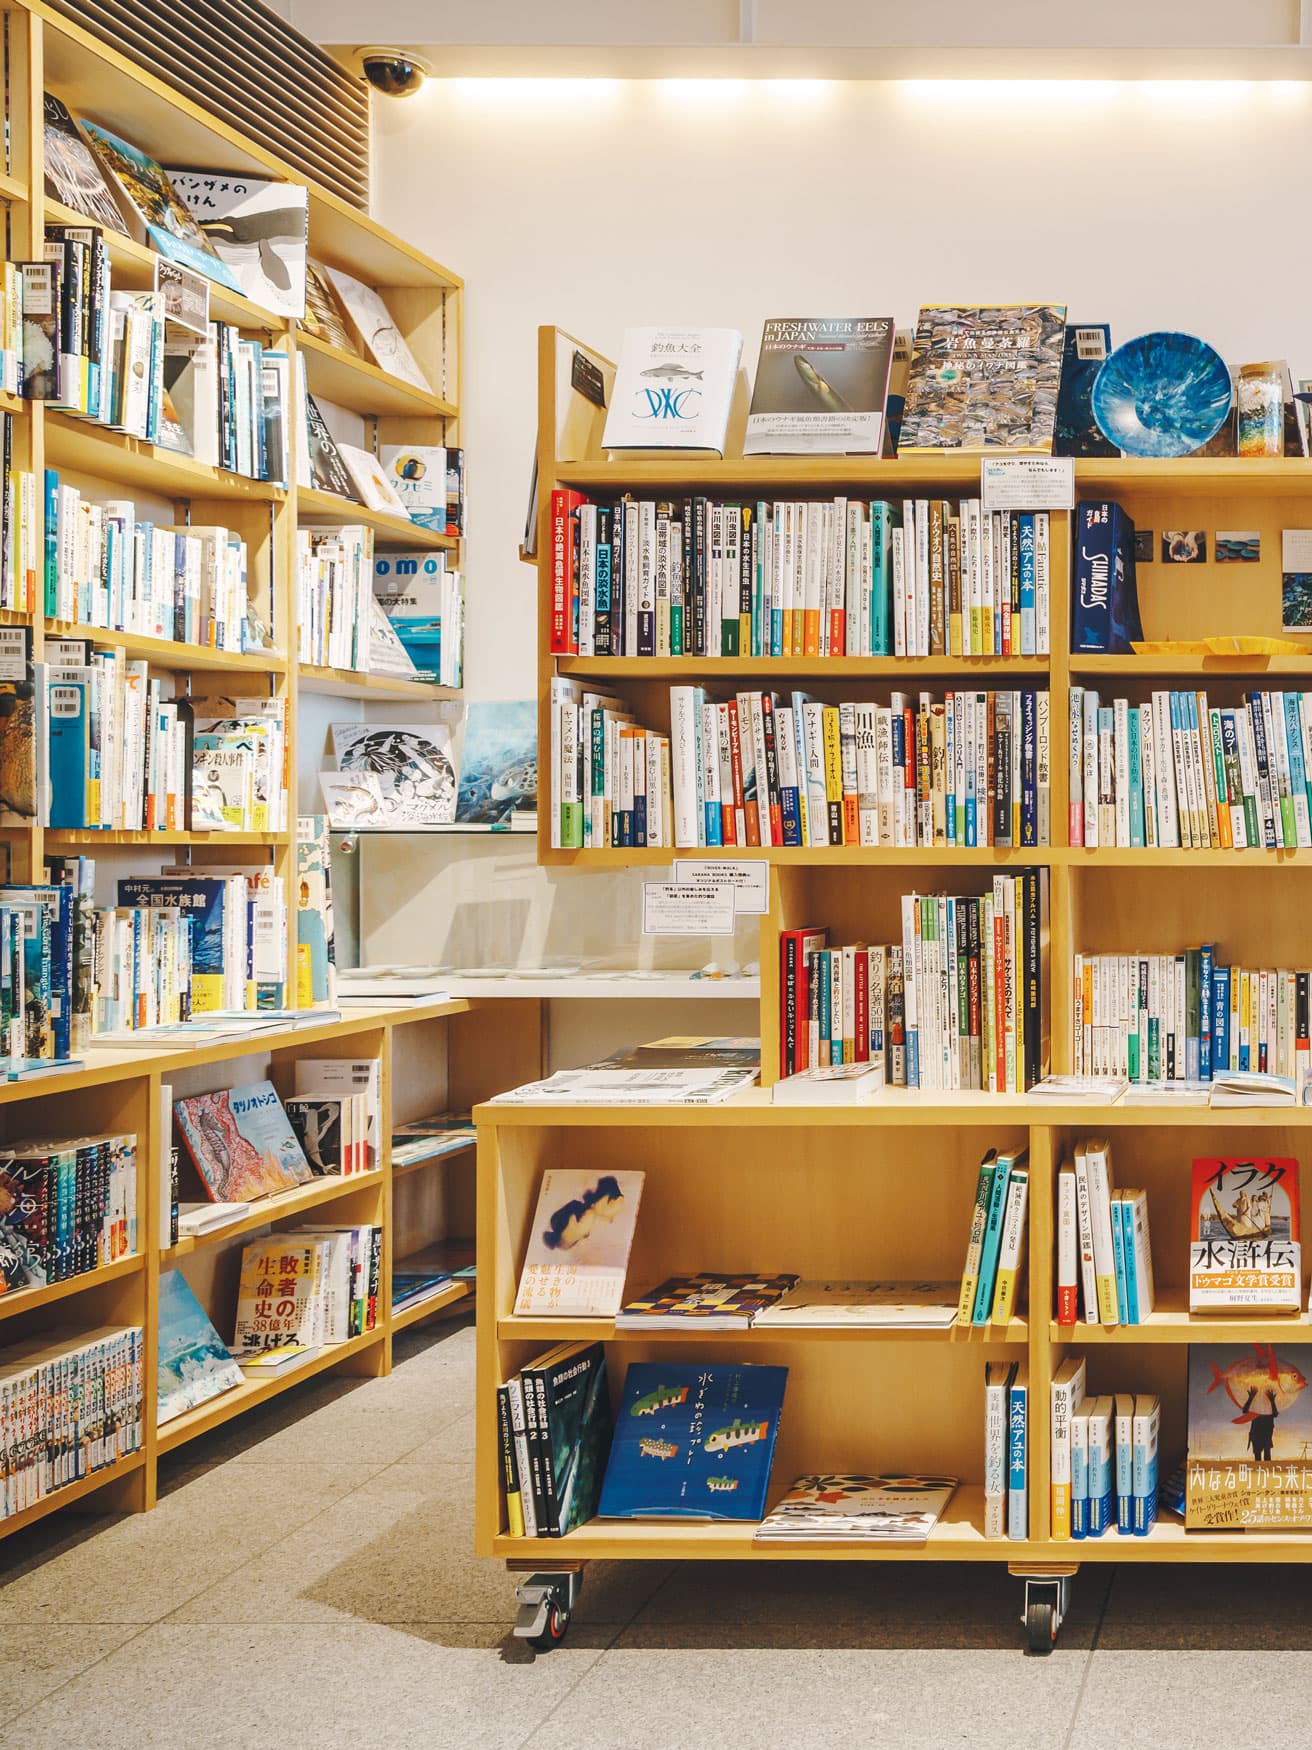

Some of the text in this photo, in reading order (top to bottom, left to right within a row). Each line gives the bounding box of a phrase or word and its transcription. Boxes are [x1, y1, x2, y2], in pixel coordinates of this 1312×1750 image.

[651, 343, 703, 353] 釣魚大全
[765, 322, 889, 333] FRESHWATER EELS
[765, 332, 774, 341] in
[776, 331, 816, 341] JAPAN
[931, 511, 942, 582] トゲウオの自然史
[1021, 526, 1034, 592] 天然アユの本
[597, 549, 610, 609] 日本の淡水魚
[1082, 546, 1111, 609] SHIMADAS
[739, 696, 748, 734] サーモン
[857, 712, 874, 749] 川漁
[720, 729, 729, 763] 鮭の歴史
[806, 709, 819, 769] ウナギと人間
[878, 716, 889, 763] 職漁師伝
[1038, 698, 1049, 783] バンブーロッド教書
[1223, 719, 1237, 765] 海のプール
[136, 893, 207, 908] 全国水族館
[870, 952, 883, 1029] 釣りの名著50冊
[232, 1090, 278, 1114] タツノオトシゴ
[1204, 1160, 1287, 1192] イラク
[1079, 1176, 1091, 1250] 民具のデザイン図鑑
[1193, 1241, 1295, 1270] 水滸伝
[254, 1257, 277, 1318] 生命史
[276, 1256, 299, 1317] 敗者の
[548, 1264, 562, 1309] 生き物が
[1193, 1275, 1295, 1288] ドゥマゴ文学賞受賞
[252, 1319, 296, 1332] 38億年
[530, 1431, 538, 1440] 2
[542, 1431, 548, 1440] 3
[1011, 1400, 1025, 1472] 天然アユの本
[1054, 1388, 1067, 1439] 動的平衡
